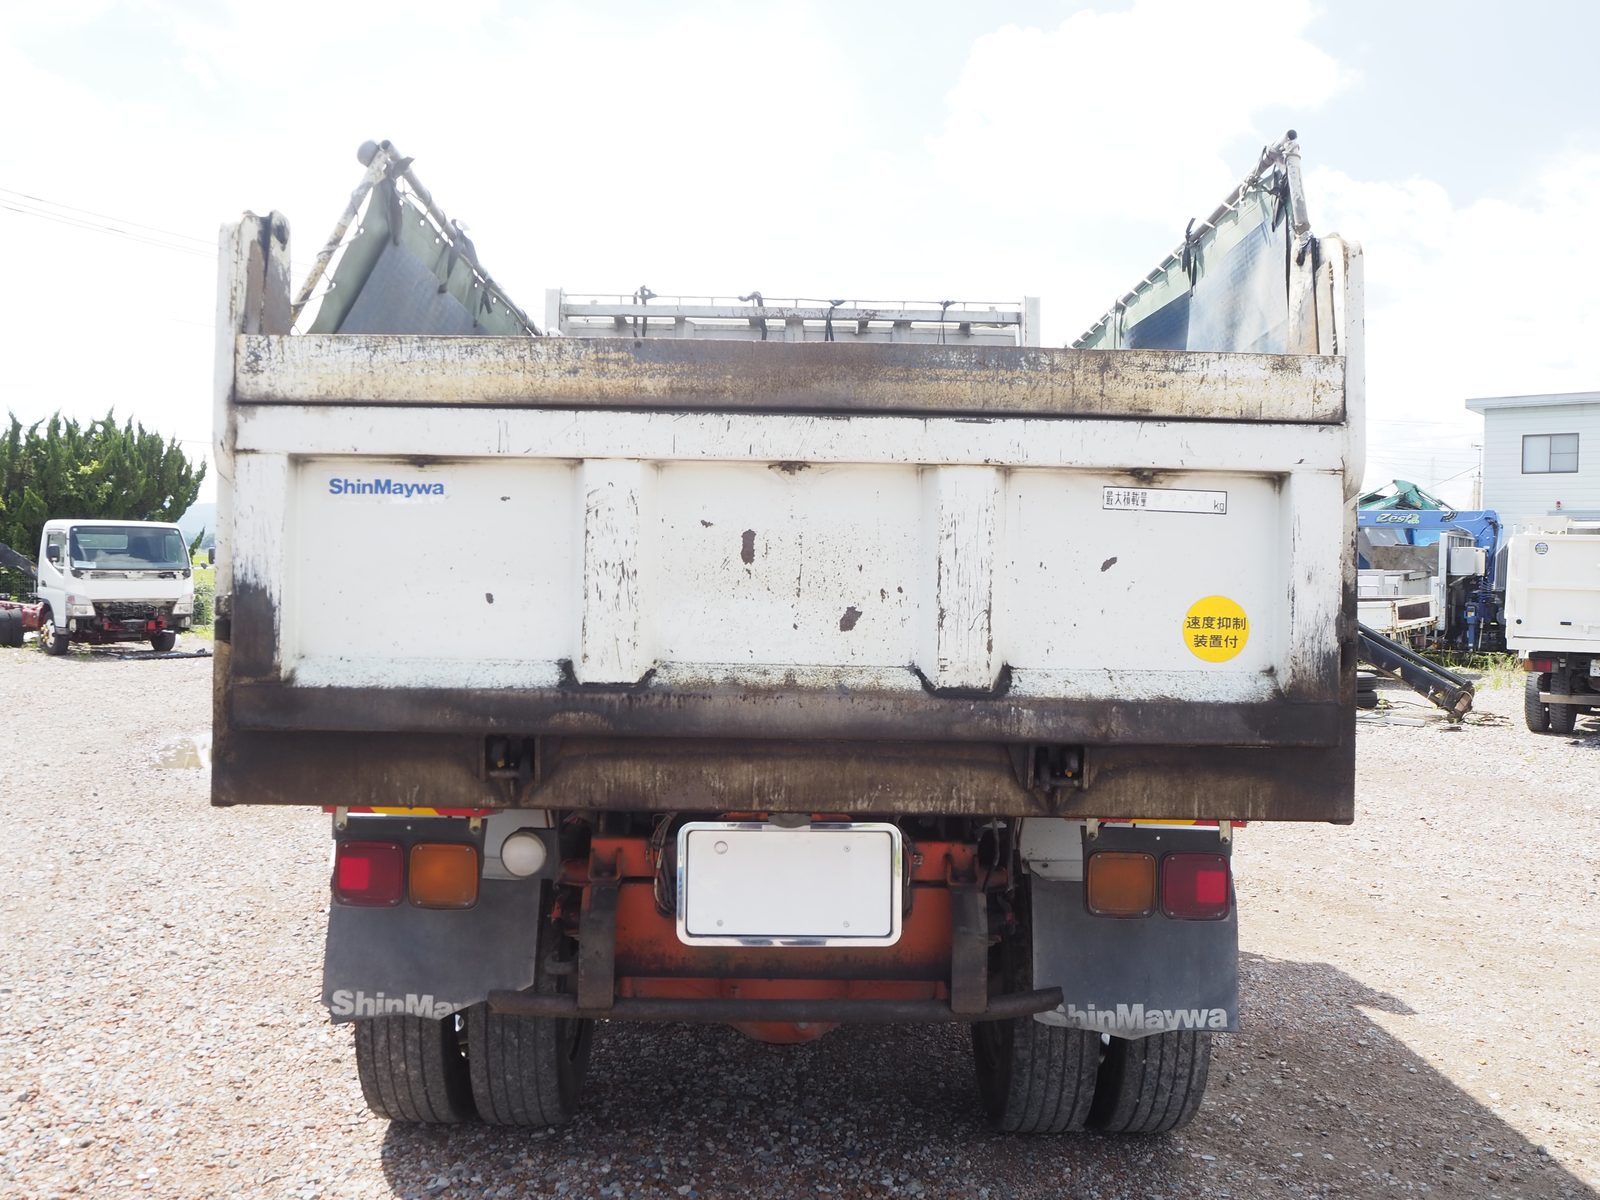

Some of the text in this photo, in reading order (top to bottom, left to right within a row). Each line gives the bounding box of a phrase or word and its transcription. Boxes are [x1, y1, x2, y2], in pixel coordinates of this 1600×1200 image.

[329, 478, 444, 498] ShinMaywa
[1106, 490, 1225, 512] 最大積載量 kg
[1186, 615, 1247, 630] 速度抑制
[1193, 634, 1239, 649] 装置付
[1056, 1003, 1228, 1030] hinMaywa
